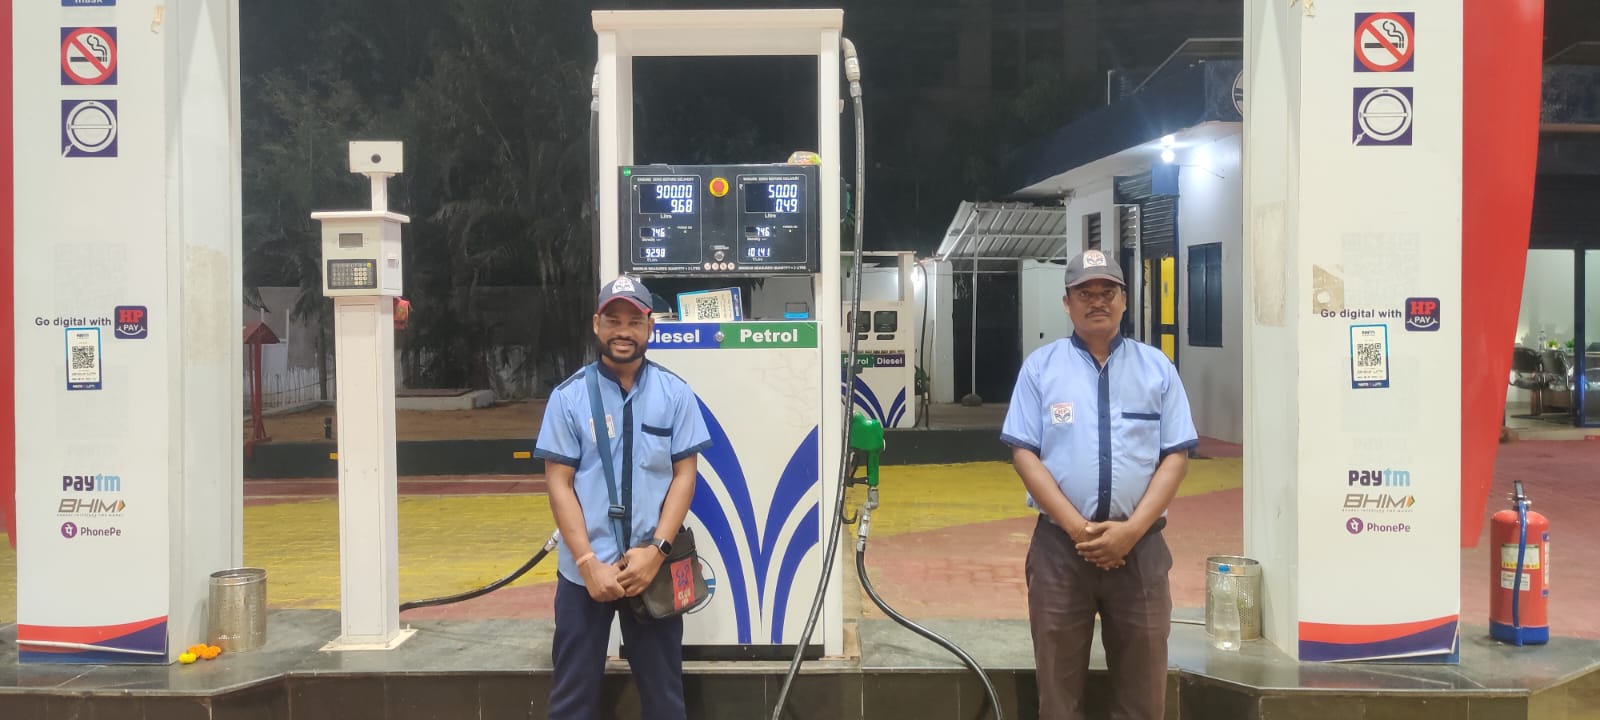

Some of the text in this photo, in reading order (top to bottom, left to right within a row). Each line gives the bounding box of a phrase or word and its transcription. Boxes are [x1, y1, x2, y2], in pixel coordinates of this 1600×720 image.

[768, 184, 798, 198] 50.00
[671, 199, 693, 213] 9.68
[775, 198, 798, 213] 0.49
[1320, 308, 1402, 319] Go digital with
[1410, 301, 1436, 315] HP
[35, 317, 112, 327] Go digital with
[119, 309, 144, 323] HP
[1414, 316, 1431, 324] PAY
[123, 323, 139, 331] PAY
[740, 329, 798, 343] Petrol
[876, 356, 903, 365] Diesel
[63, 473, 120, 491] paytm
[1349, 468, 1410, 486] paytm
[58, 499, 117, 512] BHIM
[1344, 494, 1406, 508] BHIM
[80, 527, 121, 536] PhonePe
[1367, 522, 1411, 533] PhonePe
